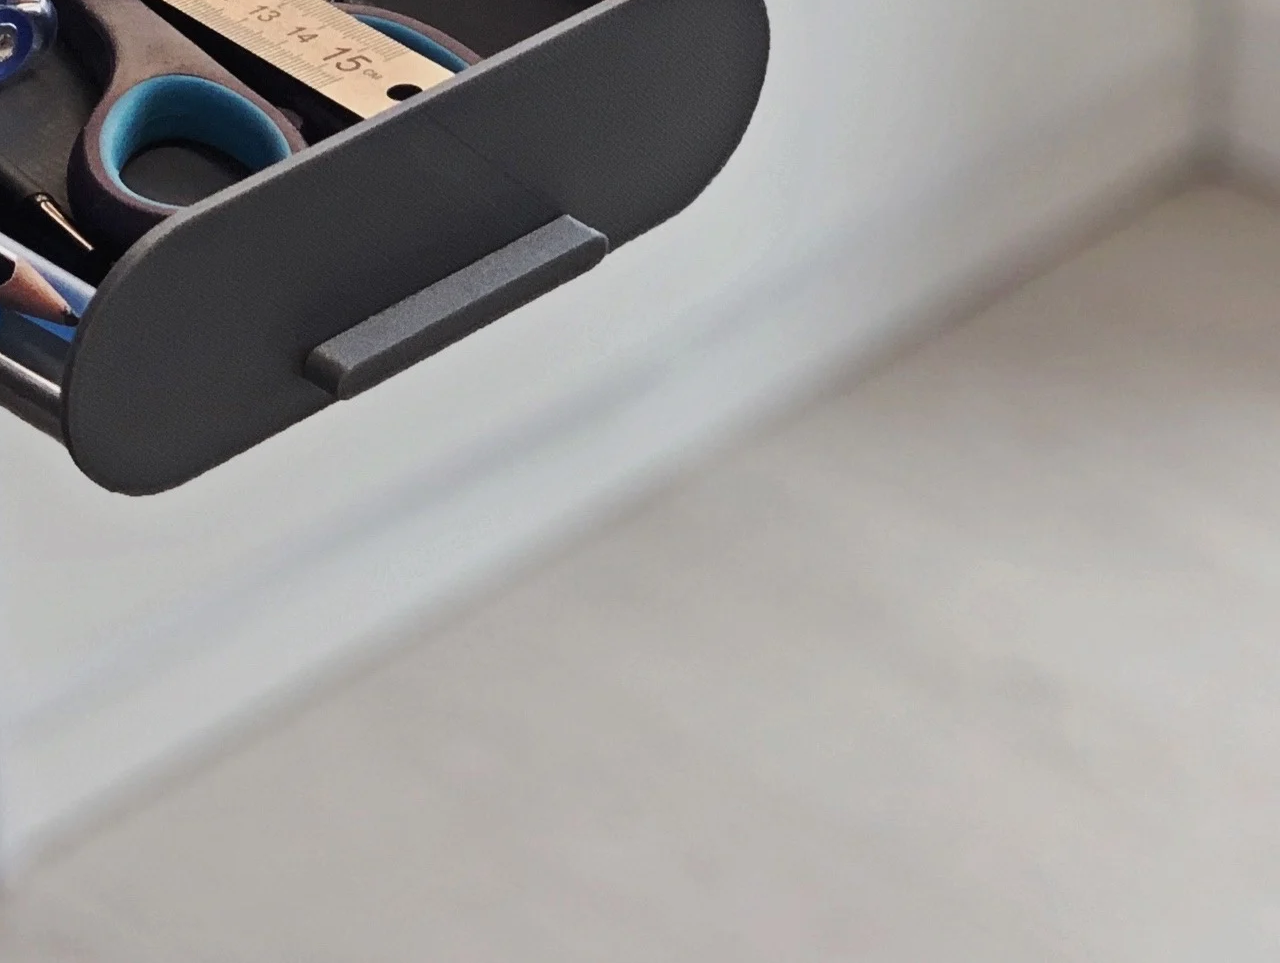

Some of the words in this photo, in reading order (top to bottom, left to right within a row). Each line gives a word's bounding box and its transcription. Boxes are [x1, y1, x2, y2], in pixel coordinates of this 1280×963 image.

[249, 4, 281, 22] 13
[287, 26, 319, 43] 14
[323, 47, 373, 72] 15
